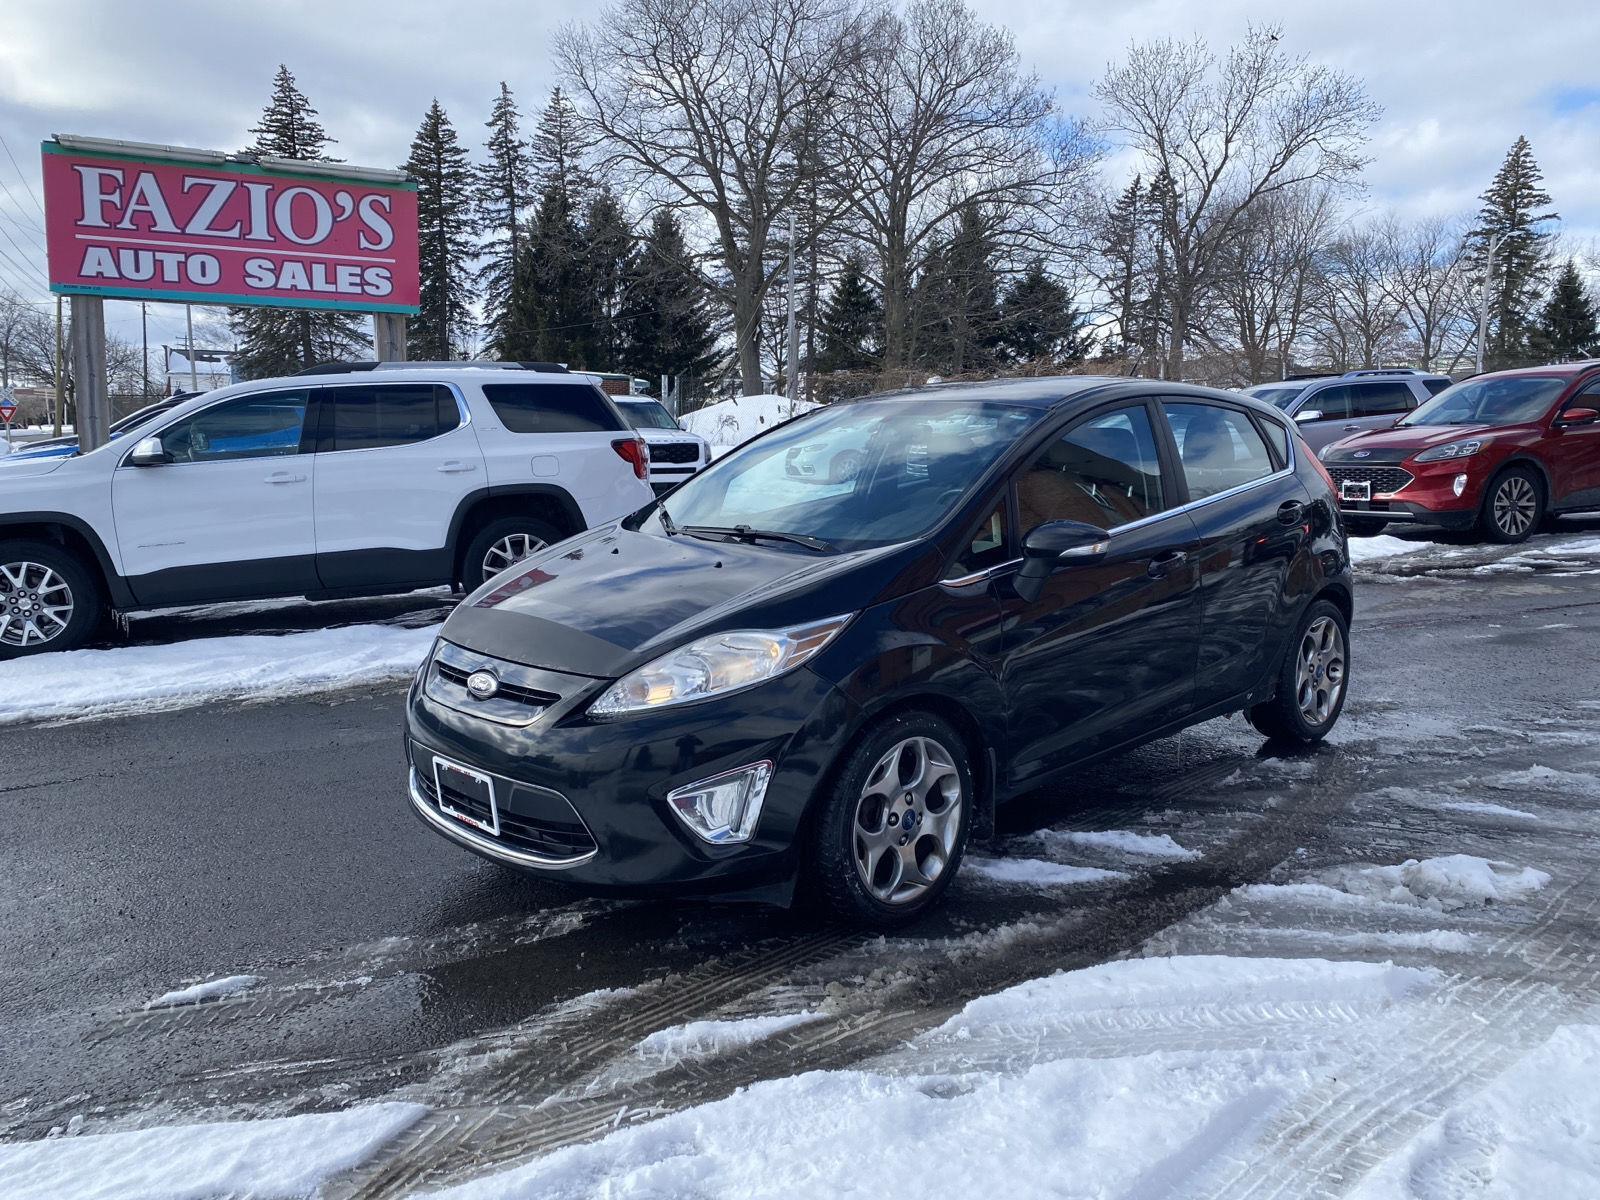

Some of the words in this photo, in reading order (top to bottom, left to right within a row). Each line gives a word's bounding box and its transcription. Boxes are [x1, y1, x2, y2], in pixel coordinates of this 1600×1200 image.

[73, 165, 395, 251] FAZIO'S
[79, 246, 222, 286] AUTO
[244, 258, 394, 297] SALES
